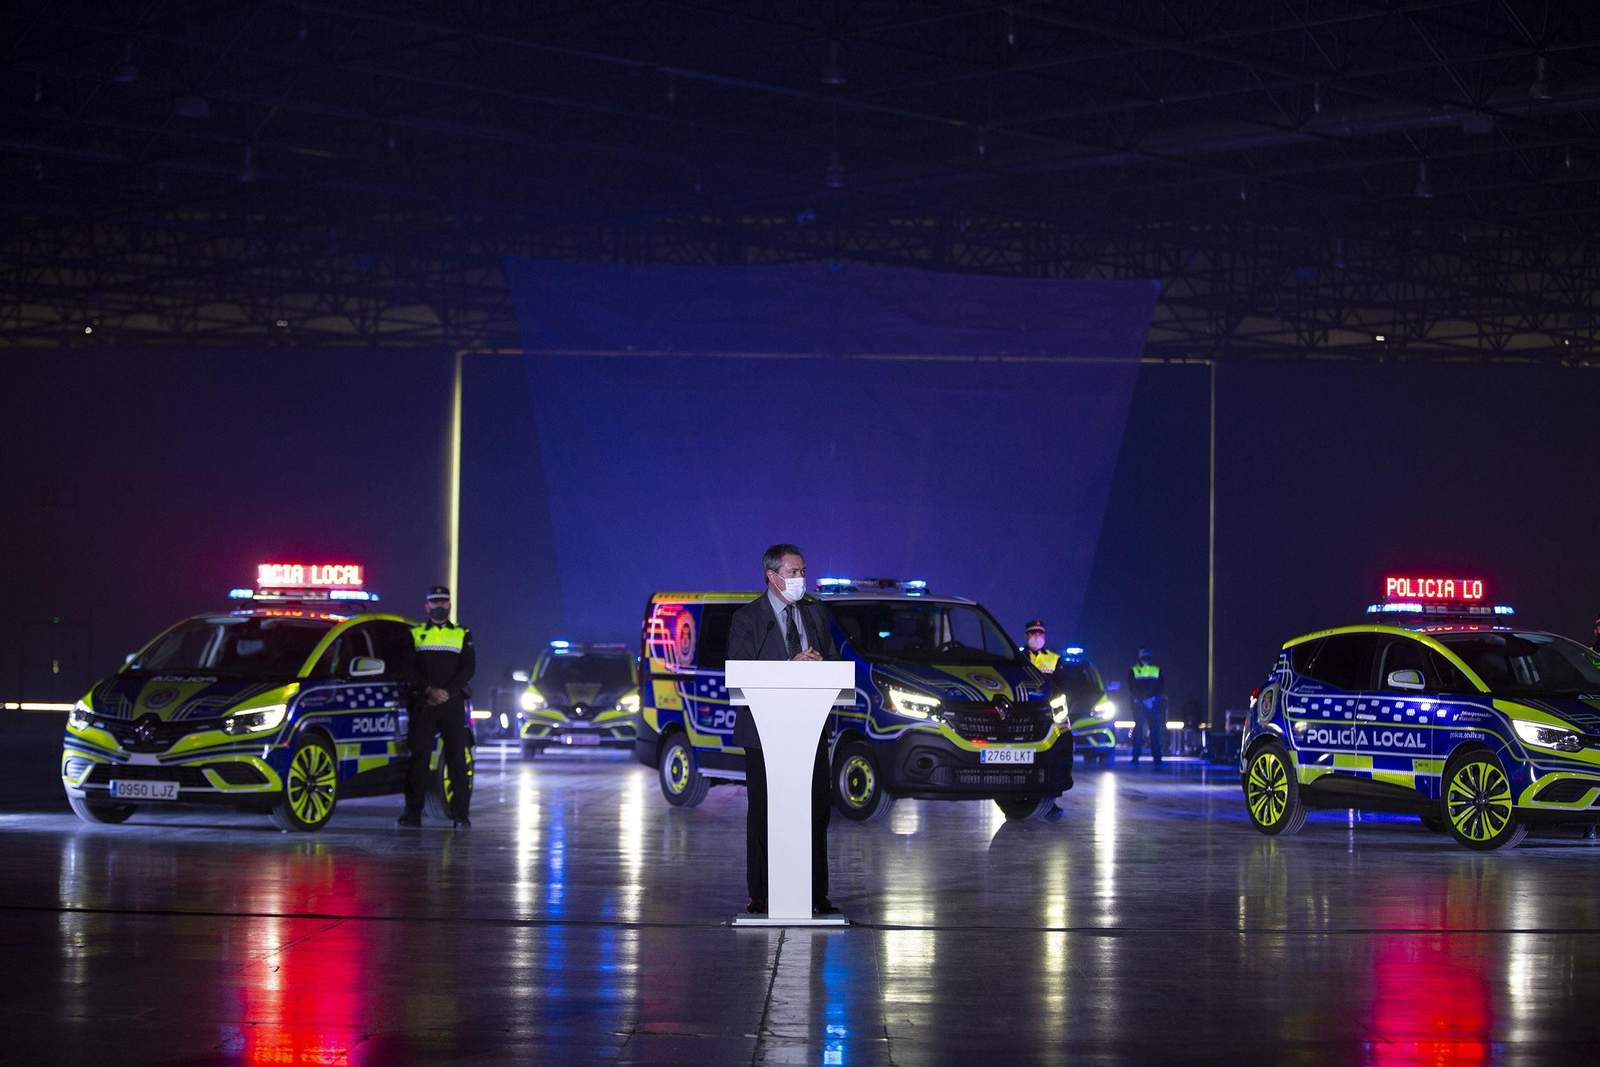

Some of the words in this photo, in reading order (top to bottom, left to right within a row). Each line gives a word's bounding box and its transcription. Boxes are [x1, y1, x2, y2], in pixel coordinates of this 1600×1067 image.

[311, 565, 362, 584] LOCAL
[1387, 578, 1454, 598] POLICIA
[1463, 580, 1482, 599] LO
[352, 714, 396, 734] POLICÍA
[713, 709, 737, 728] PO
[1307, 726, 1369, 746] POLICÍA
[1373, 731, 1427, 749] LOCAL
[987, 750, 1011, 761] 2766
[1014, 751, 1032, 762] LKT
[118, 783, 148, 796] 0950
[152, 785, 174, 797] LJZ
